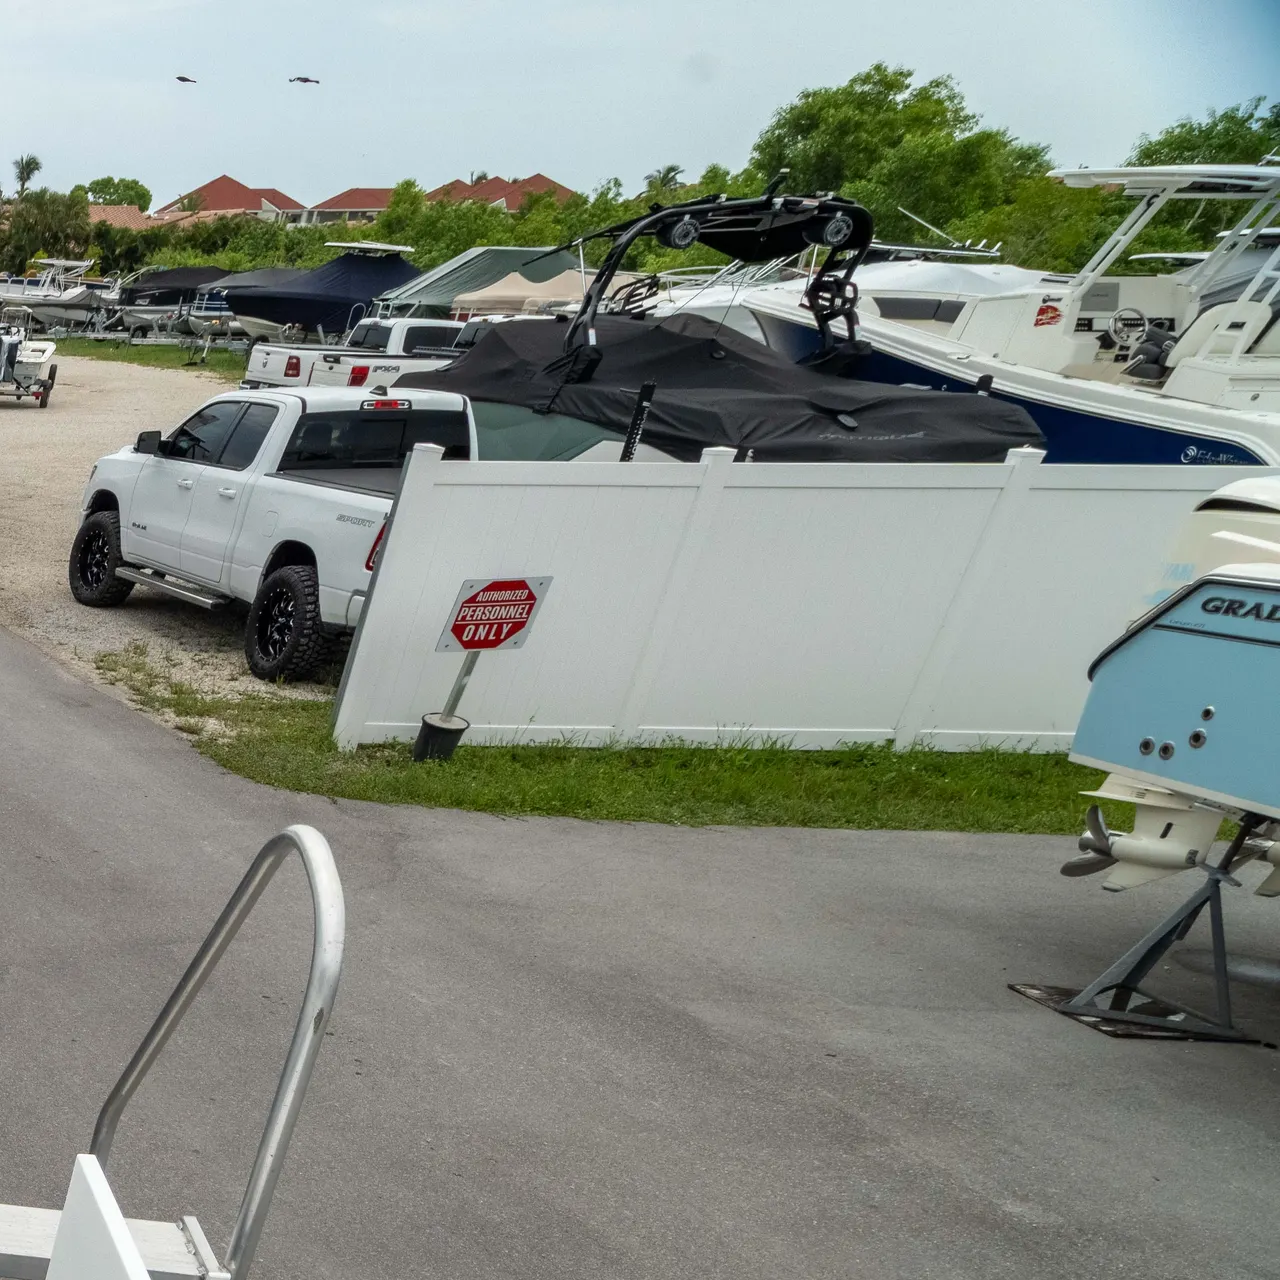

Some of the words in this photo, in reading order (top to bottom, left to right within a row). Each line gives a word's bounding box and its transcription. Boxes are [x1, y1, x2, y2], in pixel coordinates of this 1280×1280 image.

[336, 514, 375, 528] SPORT
[476, 589, 529, 602] AUTHORIZED
[458, 604, 530, 621] PERSONNEL
[462, 623, 512, 641] ONLY
